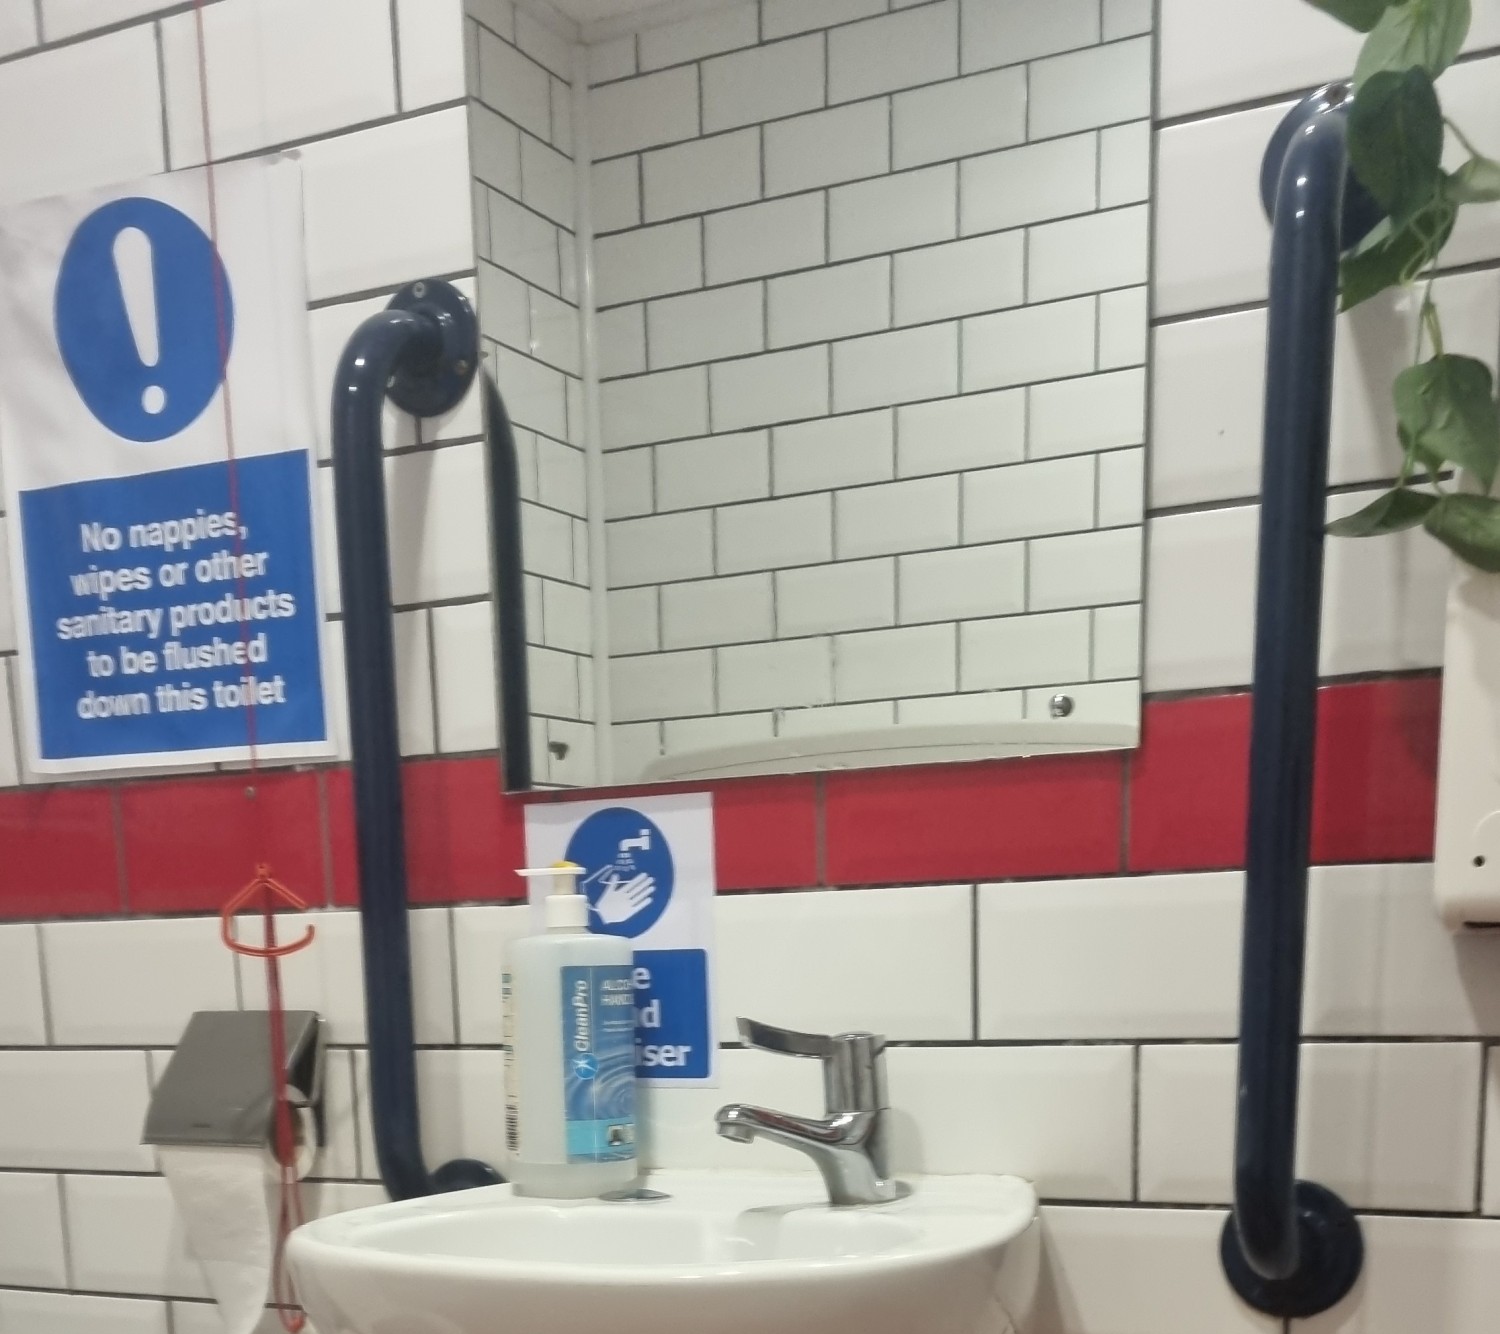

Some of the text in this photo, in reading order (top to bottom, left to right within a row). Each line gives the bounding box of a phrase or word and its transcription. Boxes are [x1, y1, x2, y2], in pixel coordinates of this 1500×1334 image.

[81, 508, 248, 552] No nappies,
[69, 550, 269, 601] wipes or other
[56, 589, 296, 640] sanitary products
[87, 632, 268, 678] to be flushed
[76, 675, 286, 720] down this toilet
[572, 980, 589, 1052] CleanPro
